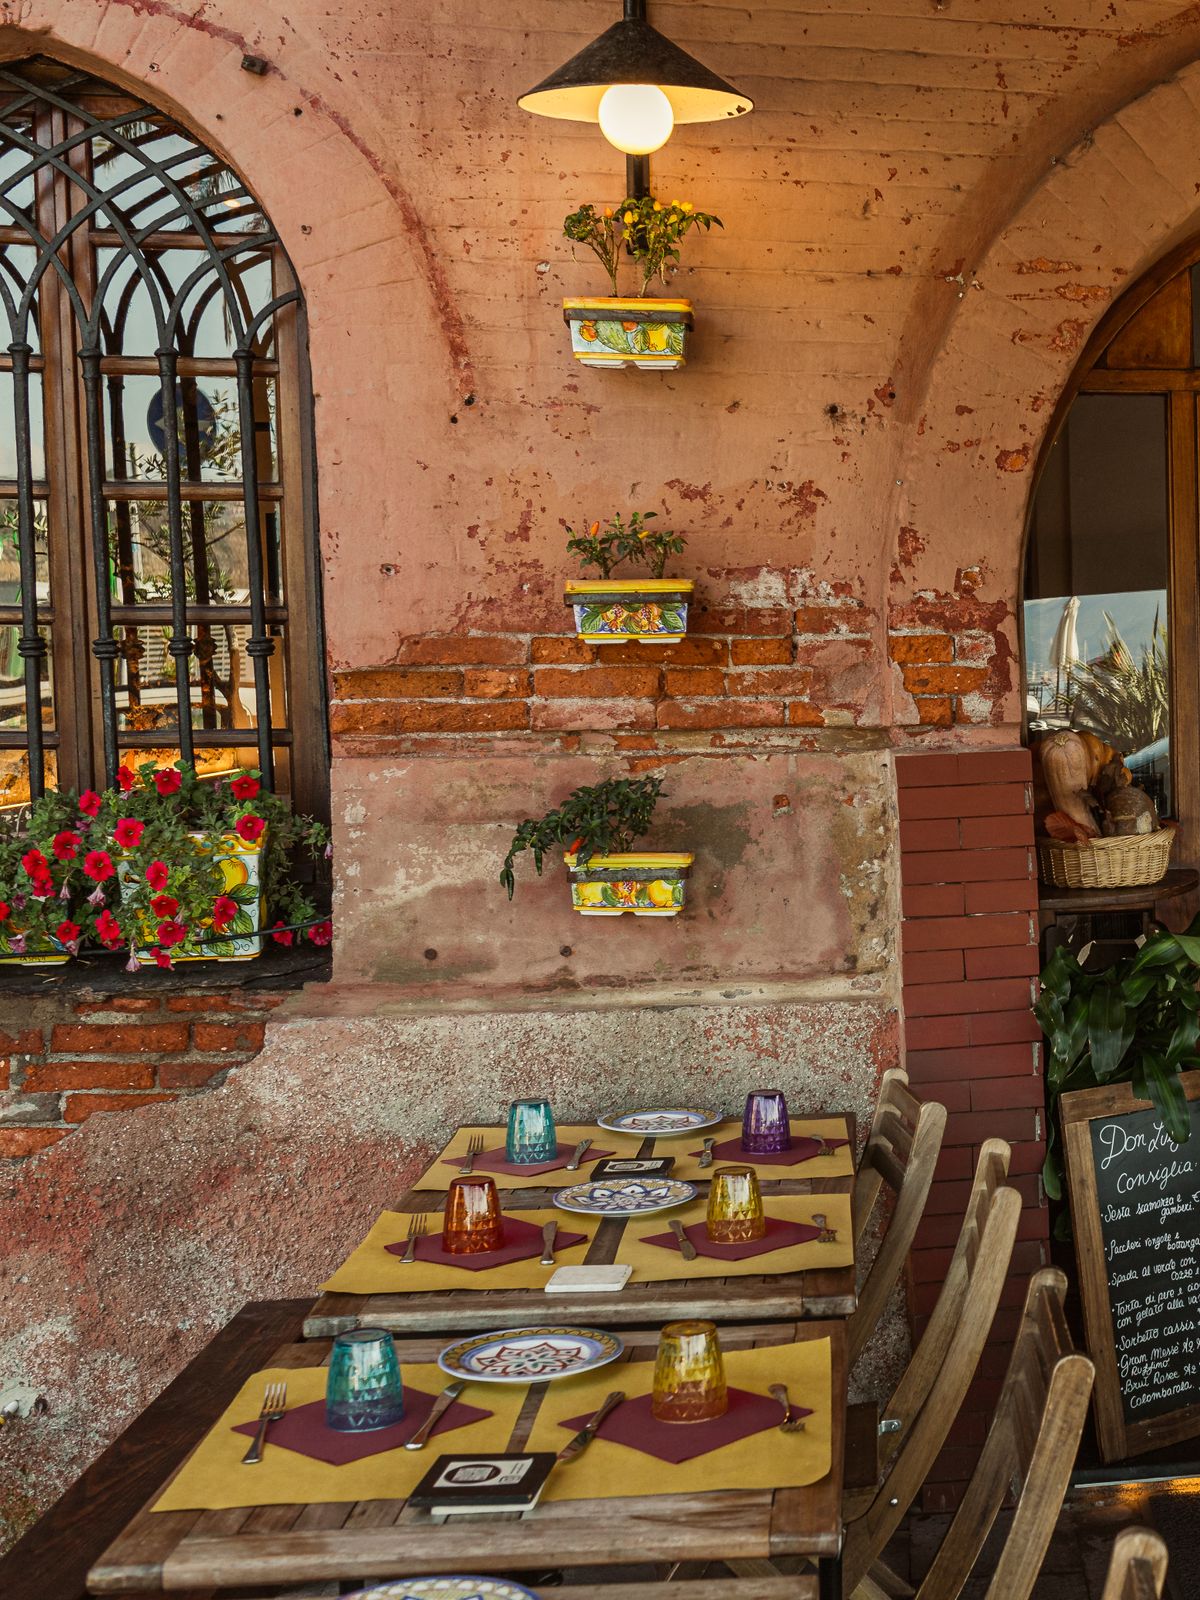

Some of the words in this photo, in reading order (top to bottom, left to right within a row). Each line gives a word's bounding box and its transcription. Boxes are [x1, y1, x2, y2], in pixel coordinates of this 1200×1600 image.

[1099, 1124, 1147, 1170] Don
[1108, 1237, 1142, 1261] Paccheri
[1111, 1270, 1139, 1287] Spada
[1141, 1265, 1151, 1277] al
[1180, 1257, 1197, 1267] con
[1115, 1300, 1142, 1316] Torta
[1145, 1291, 1155, 1305] di
[1157, 1289, 1174, 1302] pere
[1116, 1316, 1133, 1329] con
[1135, 1303, 1164, 1326] gelato
[1166, 1299, 1184, 1310] alla
[1119, 1328, 1159, 1351] Sorbetto
